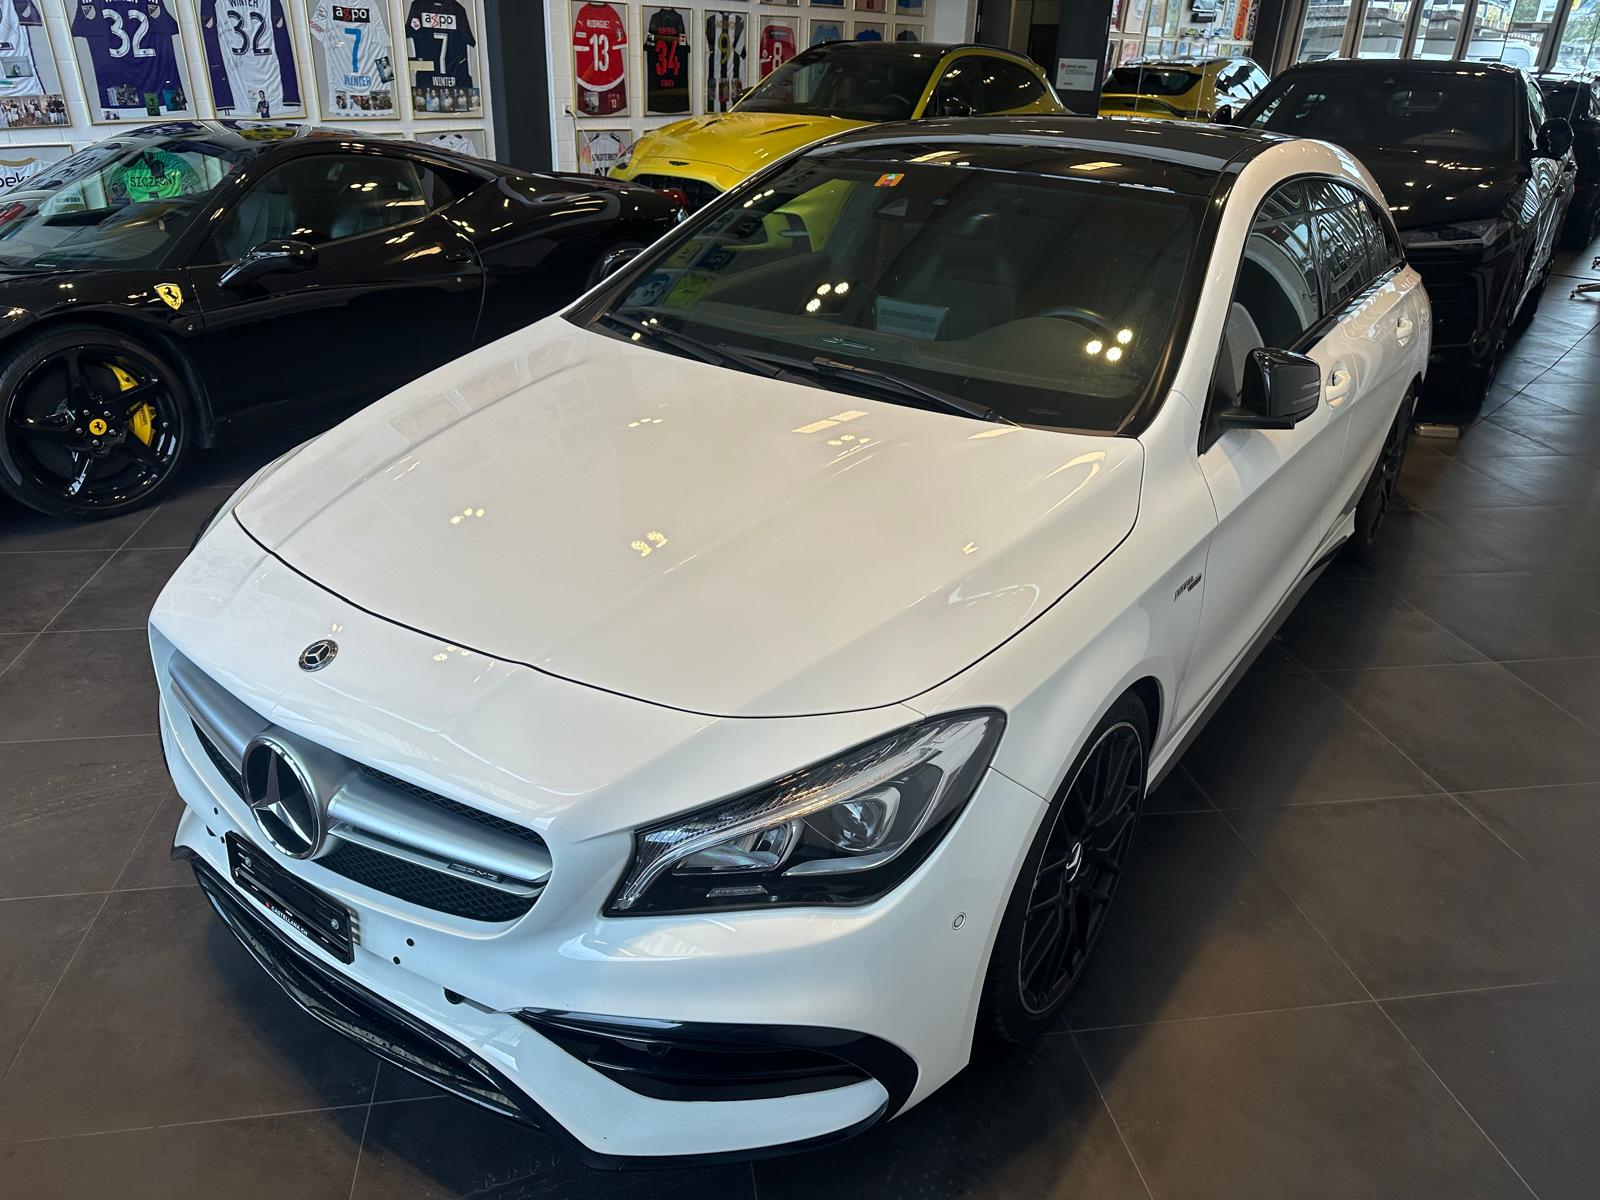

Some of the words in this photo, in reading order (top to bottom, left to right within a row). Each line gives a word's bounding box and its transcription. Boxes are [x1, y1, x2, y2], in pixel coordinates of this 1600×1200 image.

[102, 8, 156, 58] 32
[227, 10, 272, 56] 32
[344, 27, 362, 73] 7
[717, 32, 730, 64] 9
[433, 33, 448, 74] 7
[589, 33, 609, 72] 13
[655, 40, 680, 75] 34
[772, 42, 783, 71] 8
[343, 74, 371, 87] WINTER
[432, 76, 456, 87] WINTER
